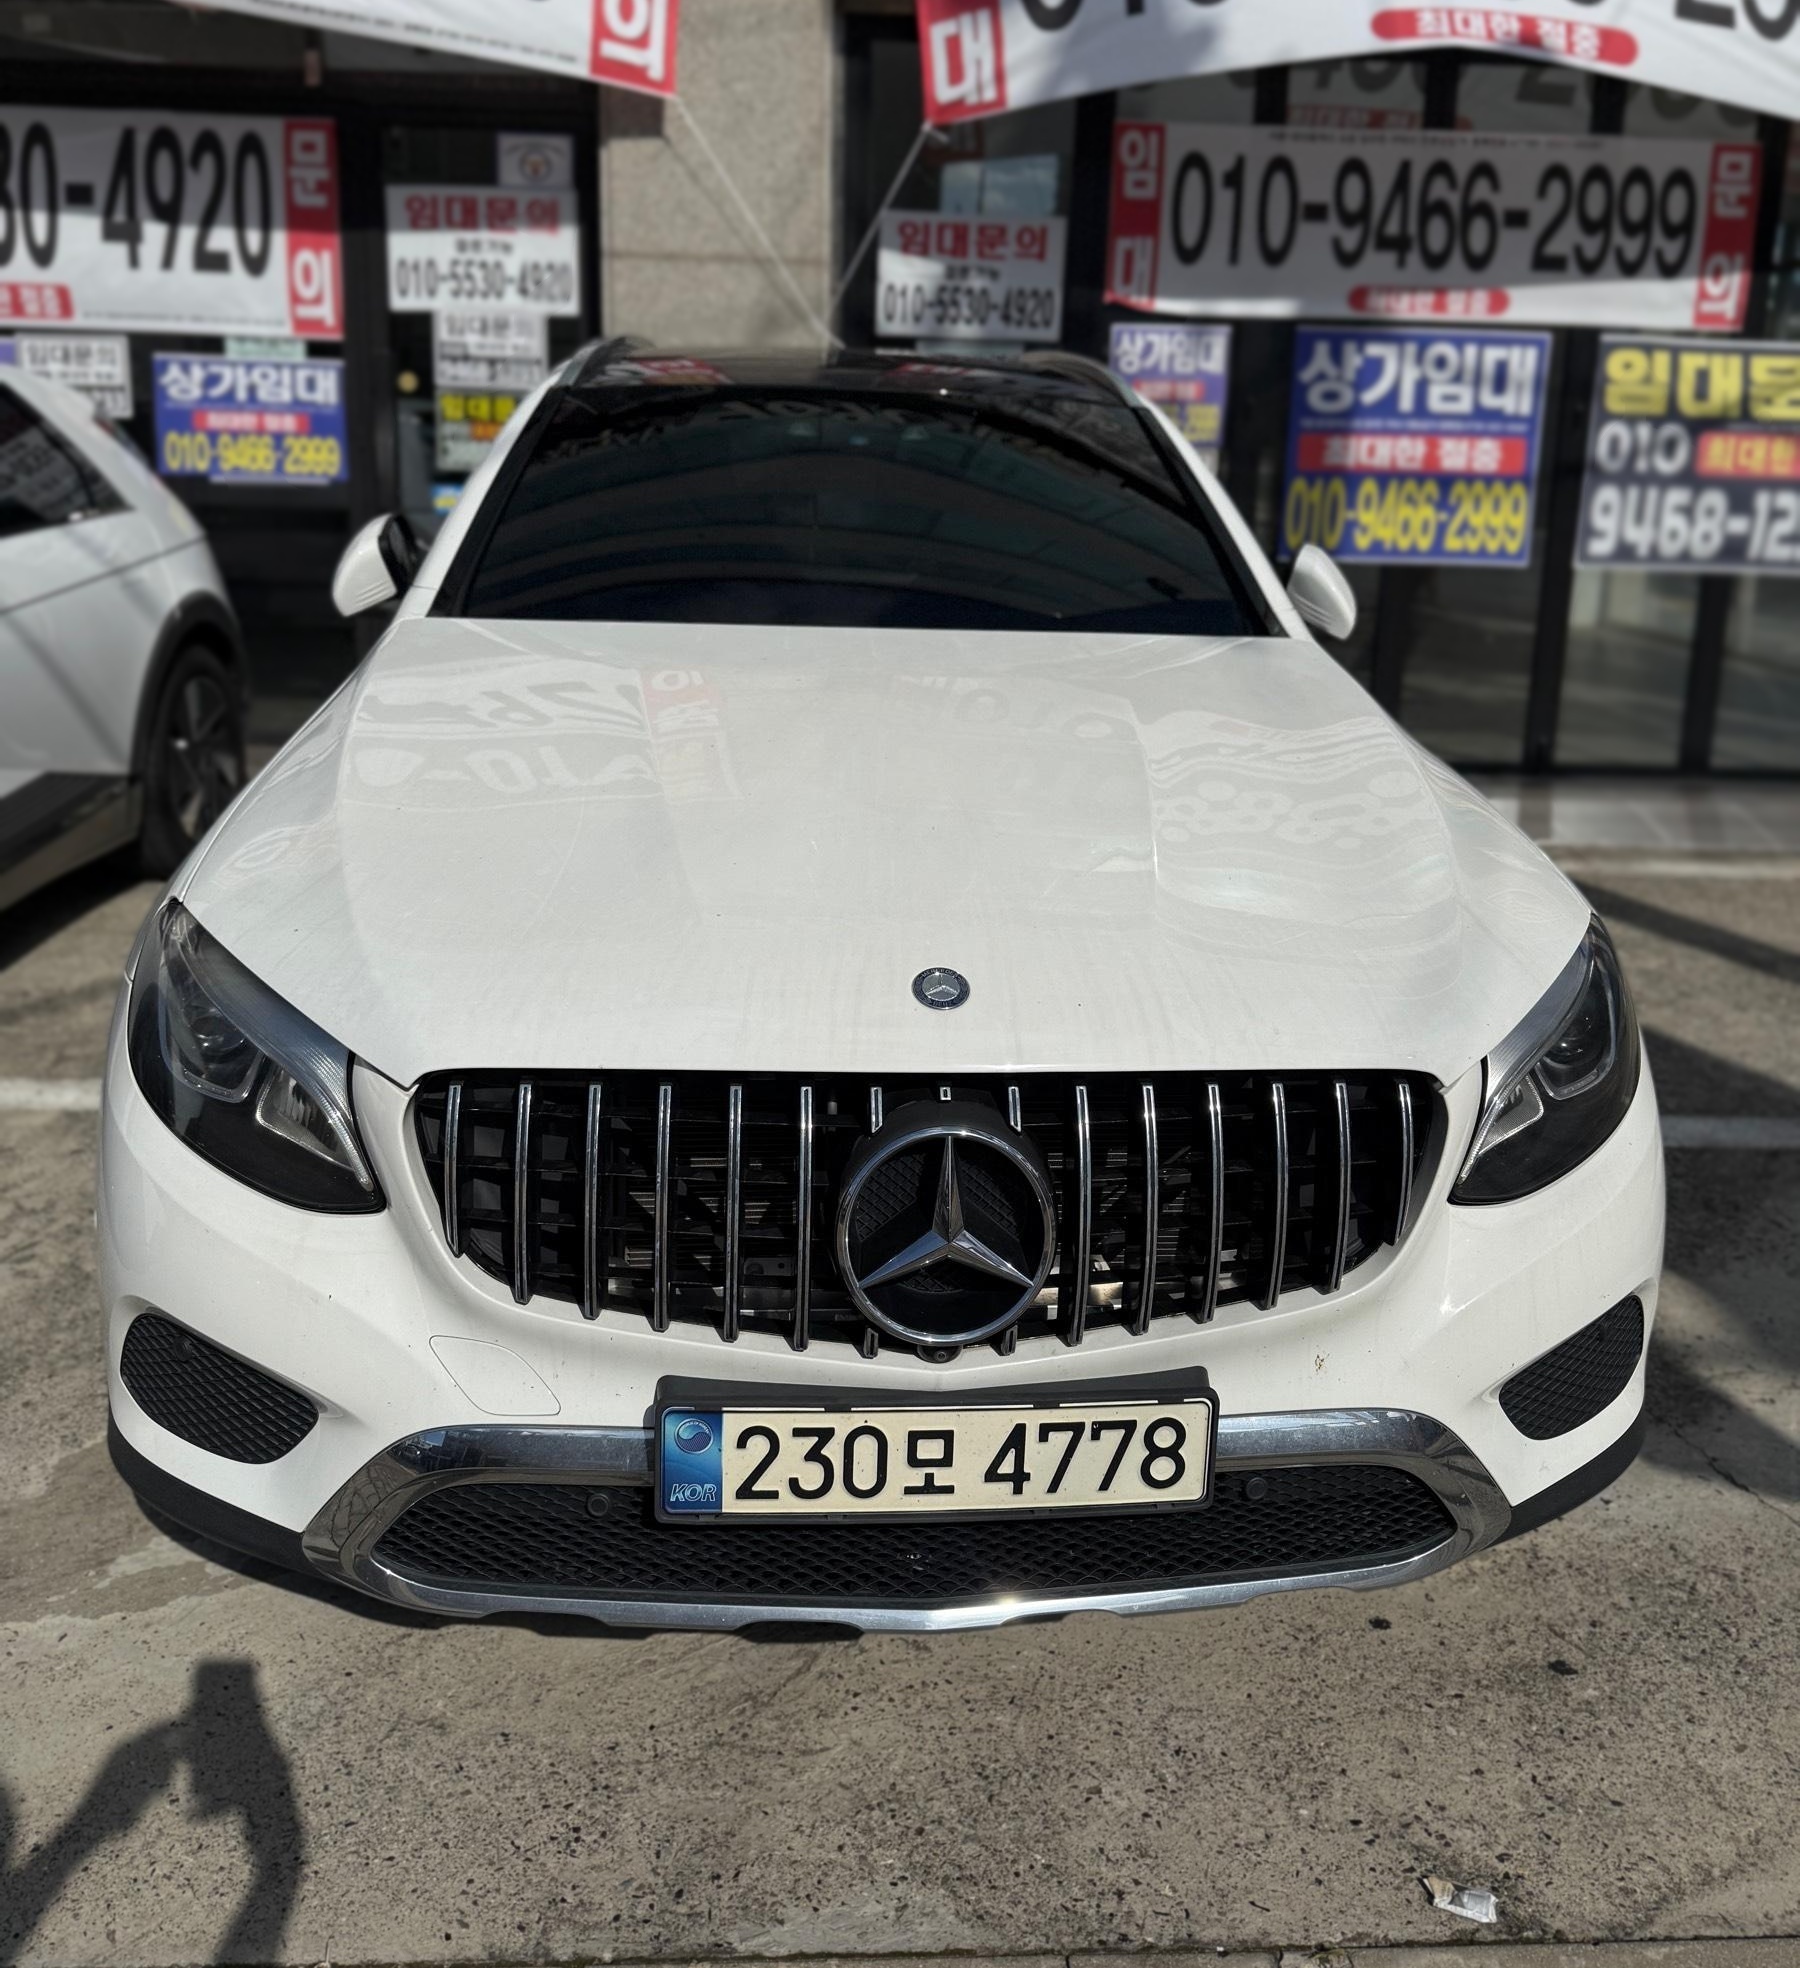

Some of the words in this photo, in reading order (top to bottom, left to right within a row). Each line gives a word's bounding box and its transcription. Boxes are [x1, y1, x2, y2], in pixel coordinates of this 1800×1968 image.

[599, 0, 668, 83] 의
[930, 7, 998, 106] 대
[405, 194, 560, 235] 임대문의
[897, 220, 1048, 262] 임대문의
[1170, 150, 1697, 279] 010-9466-2999
[396, 257, 573, 303] 010-5530-4920
[884, 282, 1056, 329] 010-5530-4920
[1116, 331, 1228, 375] 상가임대
[1298, 340, 1538, 416] 상가임대
[159, 363, 340, 406] 상가임대
[1595, 419, 1692, 477] 010
[1284, 475, 1529, 555] 010-9466-2999
[1587, 483, 1800, 561] 9468-12
[734, 1424, 955, 1500] 230모
[984, 1416, 1187, 1495] 4778
[669, 1483, 717, 1502] KOR
